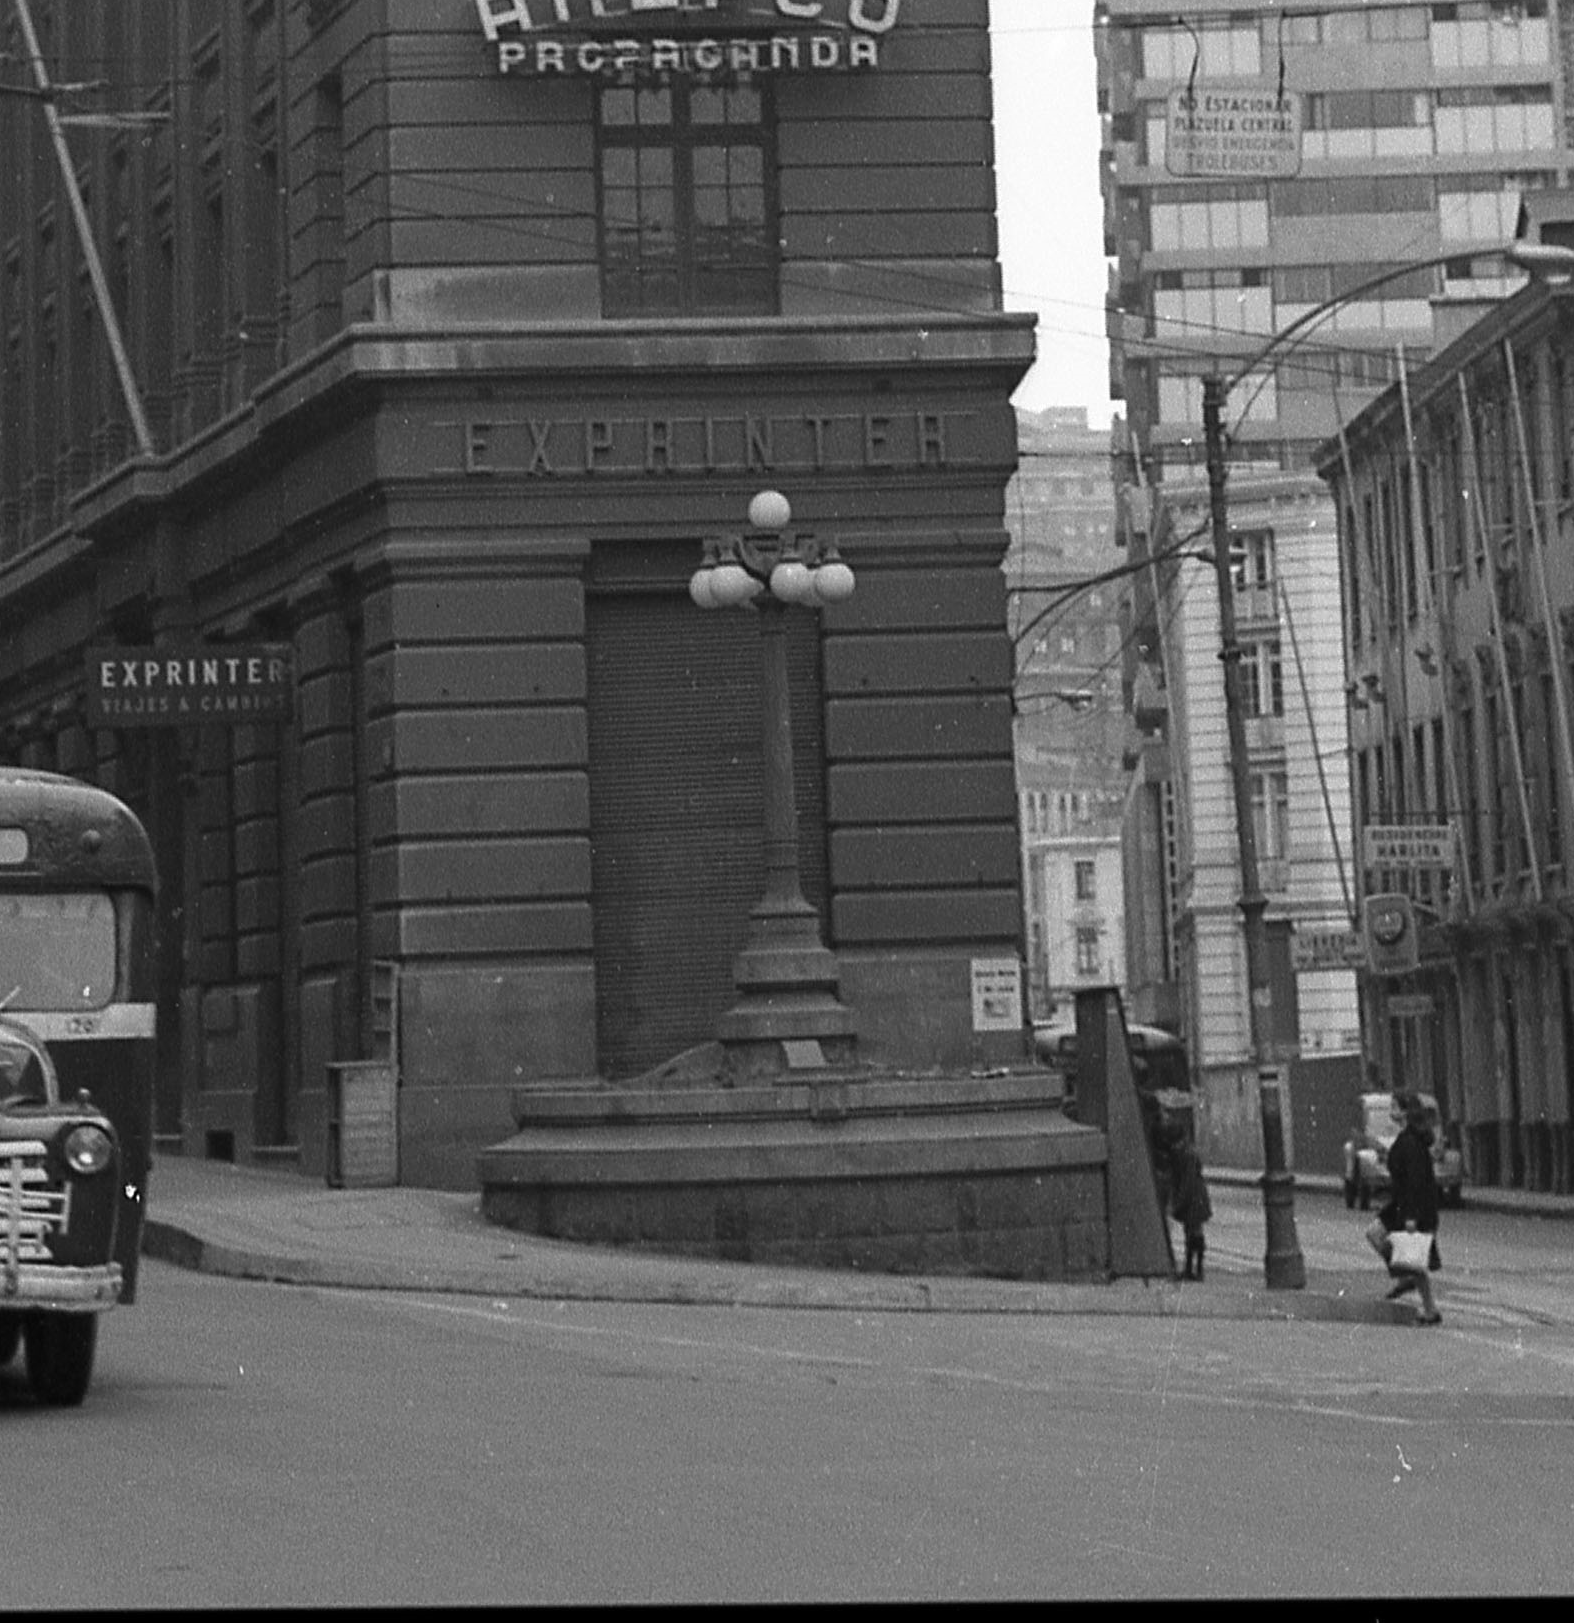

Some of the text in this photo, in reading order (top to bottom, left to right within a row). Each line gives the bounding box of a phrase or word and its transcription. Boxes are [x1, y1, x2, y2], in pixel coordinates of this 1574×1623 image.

[497, 36, 879, 74] PROPAGANDA
[1178, 96, 1292, 113] NO ESTACIONAR
[463, 414, 950, 476] EXPRINTER
[100, 657, 284, 688] EXPRINTER
